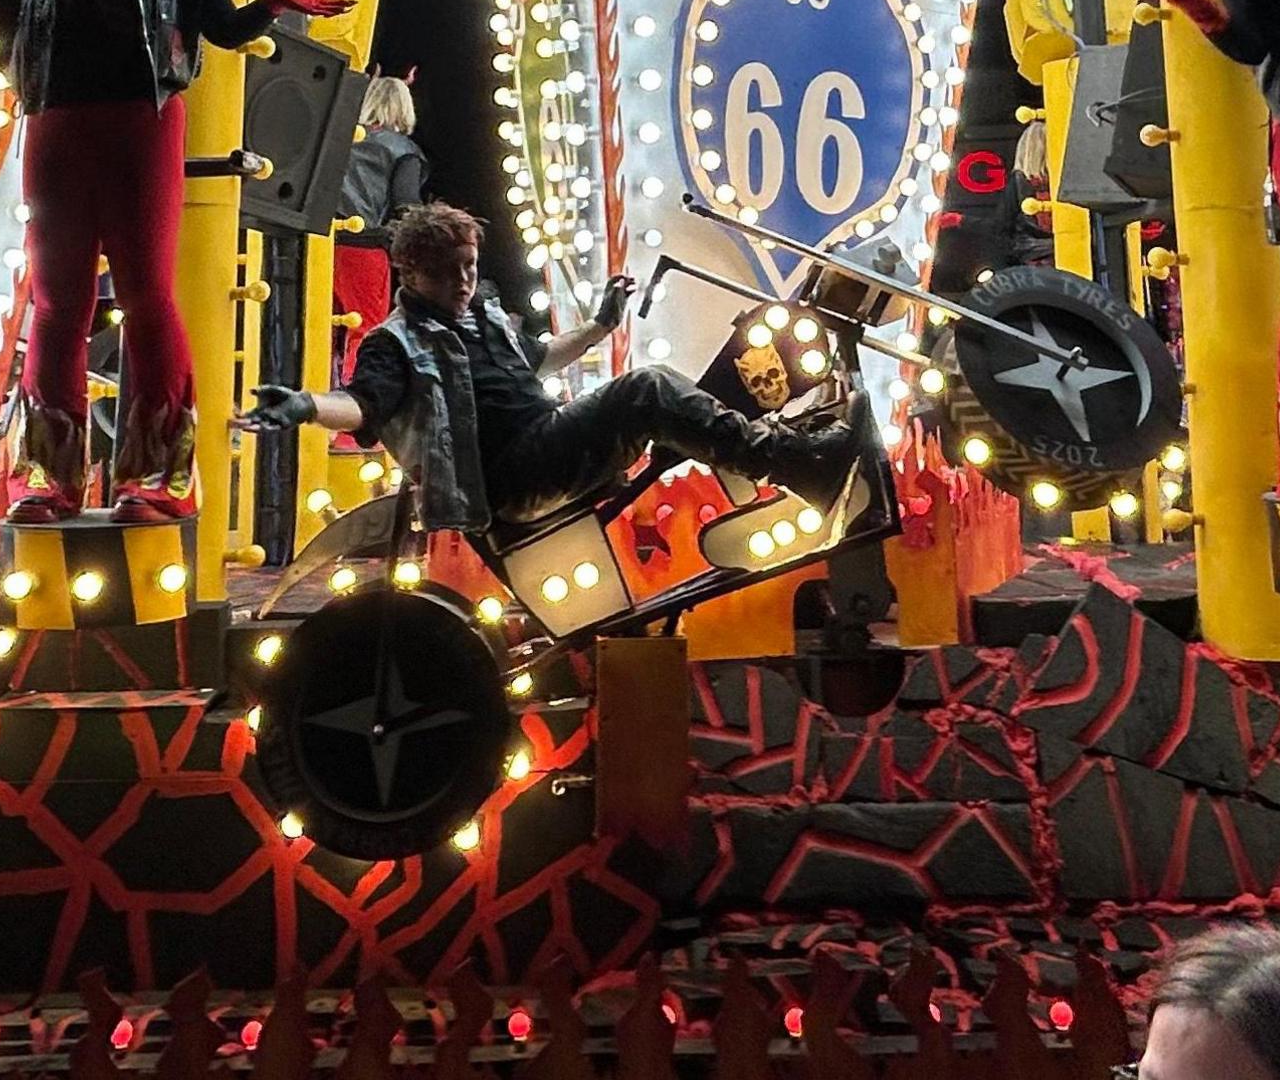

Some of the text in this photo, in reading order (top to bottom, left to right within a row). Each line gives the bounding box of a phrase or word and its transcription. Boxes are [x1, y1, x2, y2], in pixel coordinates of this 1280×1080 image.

[725, 61, 866, 215] 66
[972, 271, 1133, 330] COBRA TYRES
[1032, 434, 1105, 468] 2025
